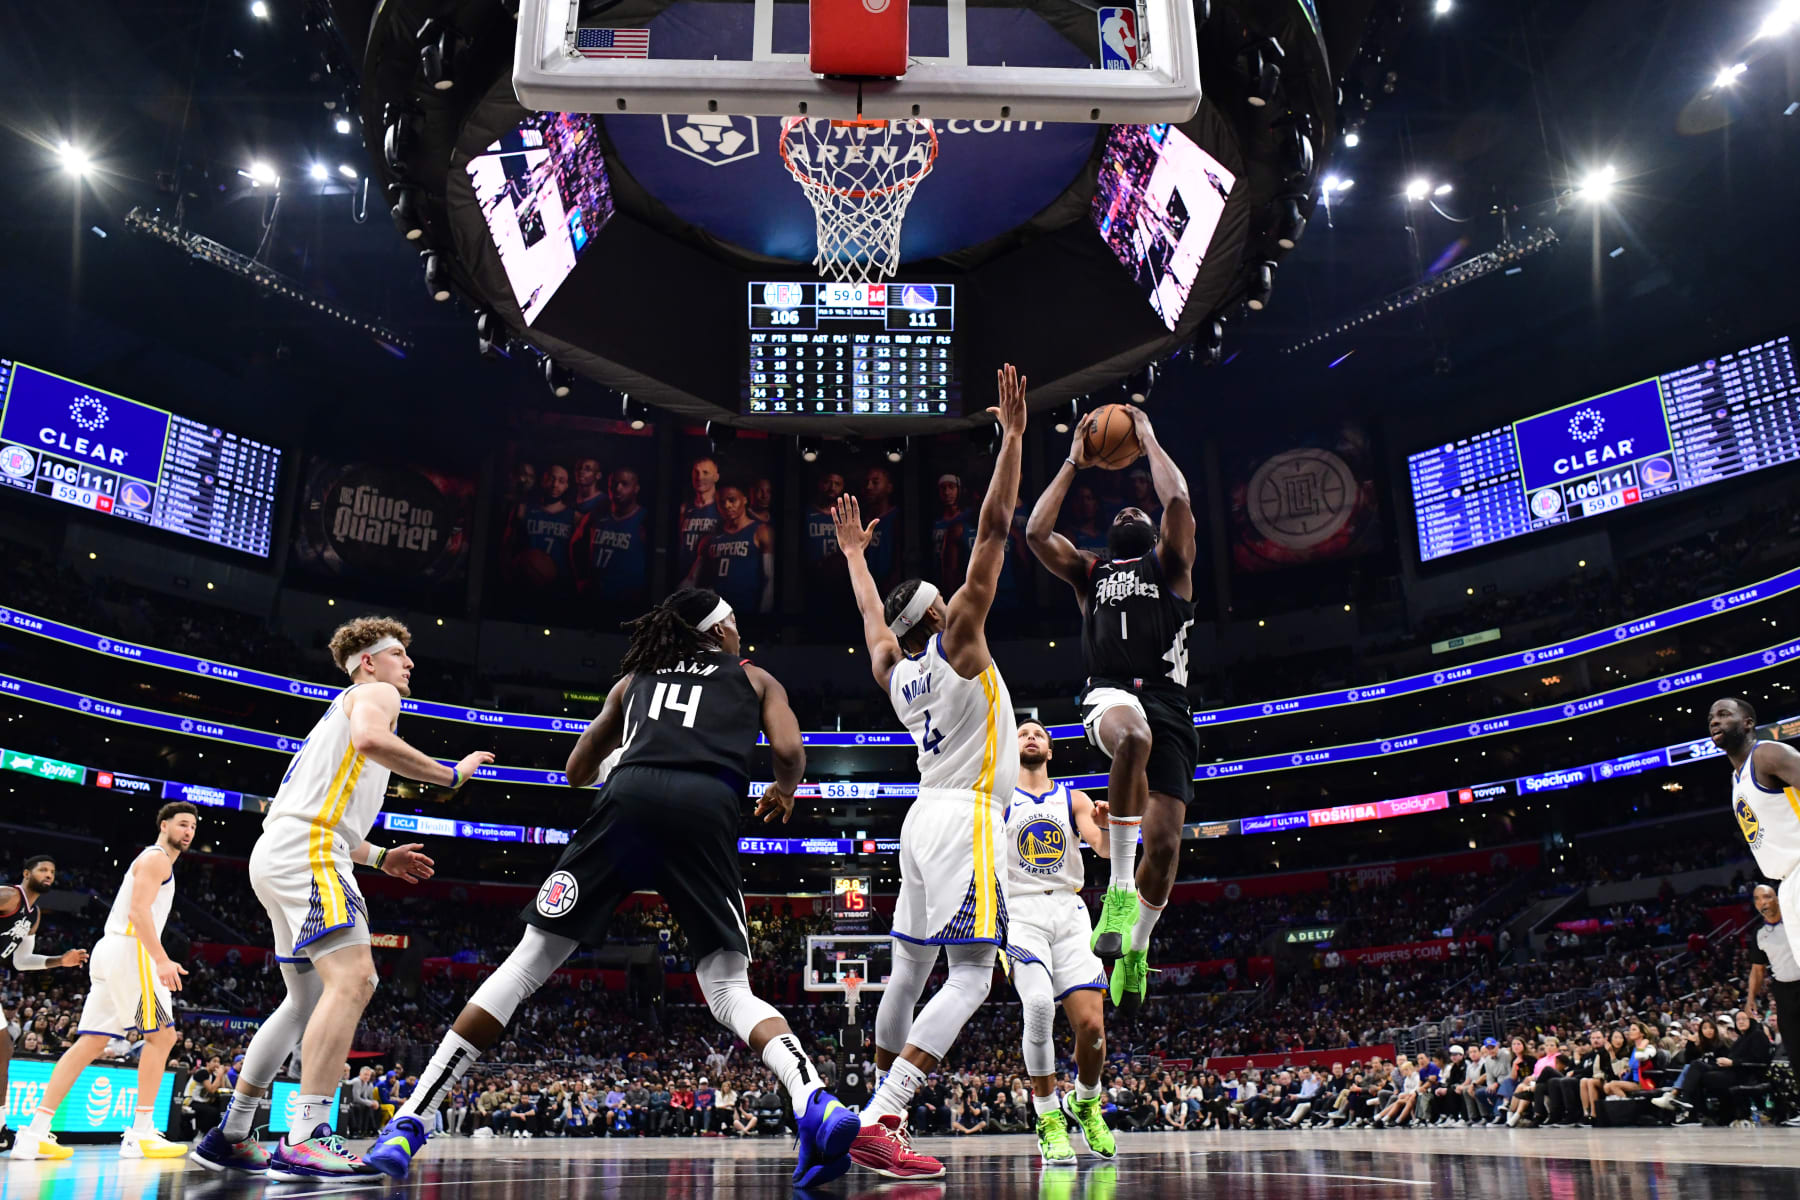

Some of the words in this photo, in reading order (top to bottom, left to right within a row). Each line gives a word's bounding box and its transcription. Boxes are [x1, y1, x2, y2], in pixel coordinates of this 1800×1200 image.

[1107, 60, 1126, 70] NBA
[791, 143, 927, 163] ARENA
[834, 290, 862, 301] 59.0
[869, 290, 884, 302] 16
[771, 310, 800, 325] 106
[909, 313, 937, 327] 111
[771, 335, 787, 343] PTS
[812, 335, 829, 343] AST
[916, 336, 932, 344] AST
[757, 347, 764, 357] 1
[774, 347, 787, 357] 19
[797, 347, 804, 357] 5
[816, 347, 824, 357] 9
[836, 347, 843, 357] 3
[878, 348, 890, 358] 12
[900, 348, 907, 358] 6
[920, 348, 927, 358] 3
[939, 348, 947, 358] 2
[757, 361, 764, 371] 2
[774, 361, 787, 371] 18
[797, 361, 804, 371] 8
[816, 361, 824, 371] 7
[836, 361, 843, 371] 2
[878, 362, 890, 371] 20
[900, 362, 907, 371] 5
[920, 362, 927, 371] 2
[939, 362, 947, 371] 3
[754, 374, 766, 384] 13
[774, 374, 787, 384] 22
[797, 374, 804, 384] 6
[816, 374, 824, 384] 5
[836, 374, 843, 384] 5
[878, 375, 890, 385] 17
[900, 375, 907, 385] 6
[920, 375, 927, 385] 2
[939, 375, 947, 385] 3
[754, 389, 766, 398] 14
[777, 389, 784, 398] 3
[797, 389, 804, 398] 2
[816, 389, 824, 398] 2
[836, 389, 843, 398] 1
[878, 390, 890, 399] 21
[900, 390, 907, 399] 9
[920, 390, 927, 399] 4
[939, 390, 947, 399] 2
[754, 402, 766, 411] 24
[774, 402, 787, 411] 12
[797, 402, 804, 411] 1
[816, 402, 824, 411] 0
[836, 402, 843, 411] 1
[878, 403, 890, 412] 22
[900, 403, 907, 412] 4
[917, 403, 929, 412] 11
[939, 403, 947, 412] 0
[39, 428, 124, 466] CLEAR
[1554, 440, 1633, 474] CLEAR
[42, 461, 77, 483] 106
[81, 472, 113, 494] 111
[1566, 481, 1599, 501] 106
[1602, 470, 1633, 491] 111
[59, 487, 91, 504] 59.0
[1589, 496, 1619, 512] 59.0
[333, 507, 437, 551] Quarter
[527, 519, 572, 537] CLIPPERS
[544, 538, 554, 554] 7
[594, 529, 631, 550] CLIPPERS
[596, 548, 613, 569] 17
[1095, 576, 1160, 606] Angeles
[1728, 590, 1758, 604] CLEAR
[14, 616, 43, 630] CLEAR
[1121, 612, 1128, 640] 1
[1629, 620, 1656, 634] CLEAR
[114, 645, 142, 657] CLEAR
[1538, 648, 1564, 660] CLEAR
[1779, 644, 1800, 658] CLEA
[212, 666, 239, 679] CLEAR
[1447, 669, 1472, 680] CLEAR
[1674, 673, 1703, 687] CLEAR
[303, 687, 329, 697] CLEAR
[1362, 688, 1386, 698] CLEAR
[95, 704, 123, 717] CLEAR
[648, 682, 703, 729] 14
[1276, 702, 1300, 712] CLEAR
[1578, 699, 1604, 712] CLEAR
[480, 715, 504, 723] CLEAR
[1193, 714, 1216, 723] CLEAR
[197, 724, 224, 736] CLEAR
[1483, 720, 1509, 731] CLEAR
[923, 710, 946, 755] 4
[1394, 738, 1418, 749] CLEAR
[1306, 753, 1330, 762] CLEAR
[1614, 755, 1660, 773] crypto.com
[40, 760, 77, 779] Sprite
[1220, 765, 1243, 773] CLEAR
[115, 778, 150, 791] TOYOTA
[1526, 771, 1583, 791] Spectrum
[182, 786, 225, 799] AMERICAN
[828, 785, 859, 797] 58.9
[869, 788, 875, 796] 4
[885, 787, 919, 796] Warriors
[1474, 786, 1506, 798] TOYOTA
[187, 794, 225, 806] EXPRESS
[1391, 796, 1435, 812] boldyn
[1017, 813, 1044, 830] GOLDEN
[1047, 814, 1066, 828] STATE
[1312, 806, 1375, 824] TOSHIBA
[394, 818, 415, 829] UCLA
[421, 821, 451, 833] Health
[1278, 817, 1306, 828] ULTRA
[474, 827, 516, 839] crypto.com
[1044, 831, 1061, 845] 30
[741, 842, 783, 851] DELTA
[877, 843, 900, 851] TOYOT
[846, 891, 865, 910] 15
